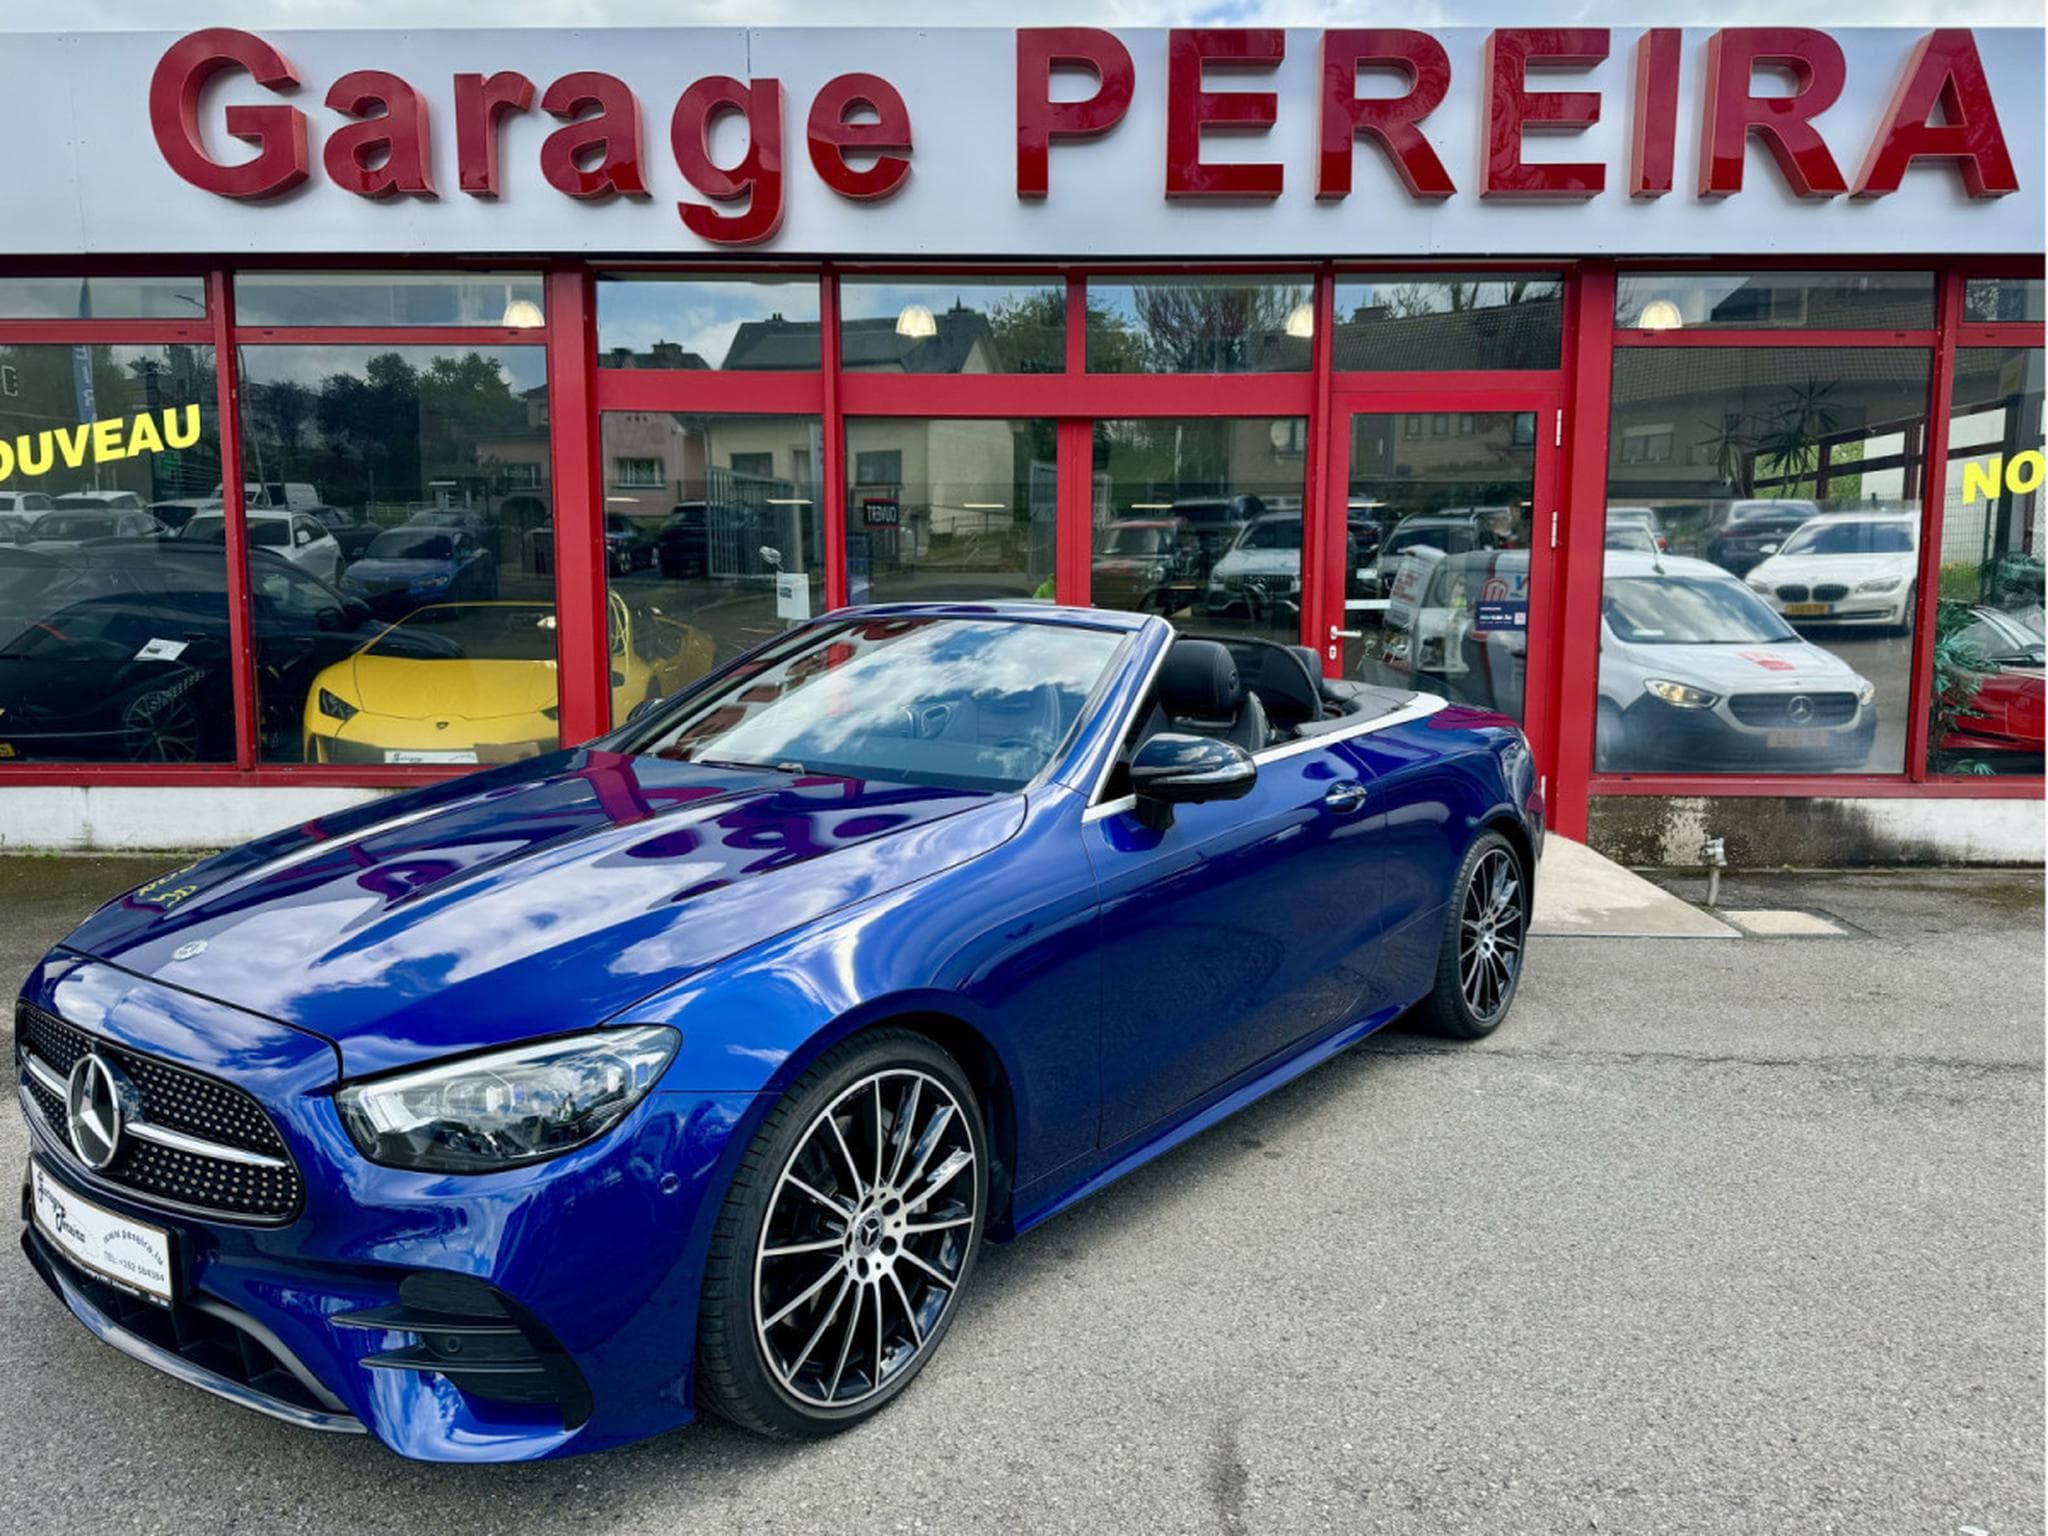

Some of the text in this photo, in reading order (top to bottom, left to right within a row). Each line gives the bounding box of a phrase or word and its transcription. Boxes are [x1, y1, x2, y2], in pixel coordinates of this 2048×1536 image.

[150, 27, 2019, 246] Garage PEREIRA
[1962, 450, 2046, 505] NO
